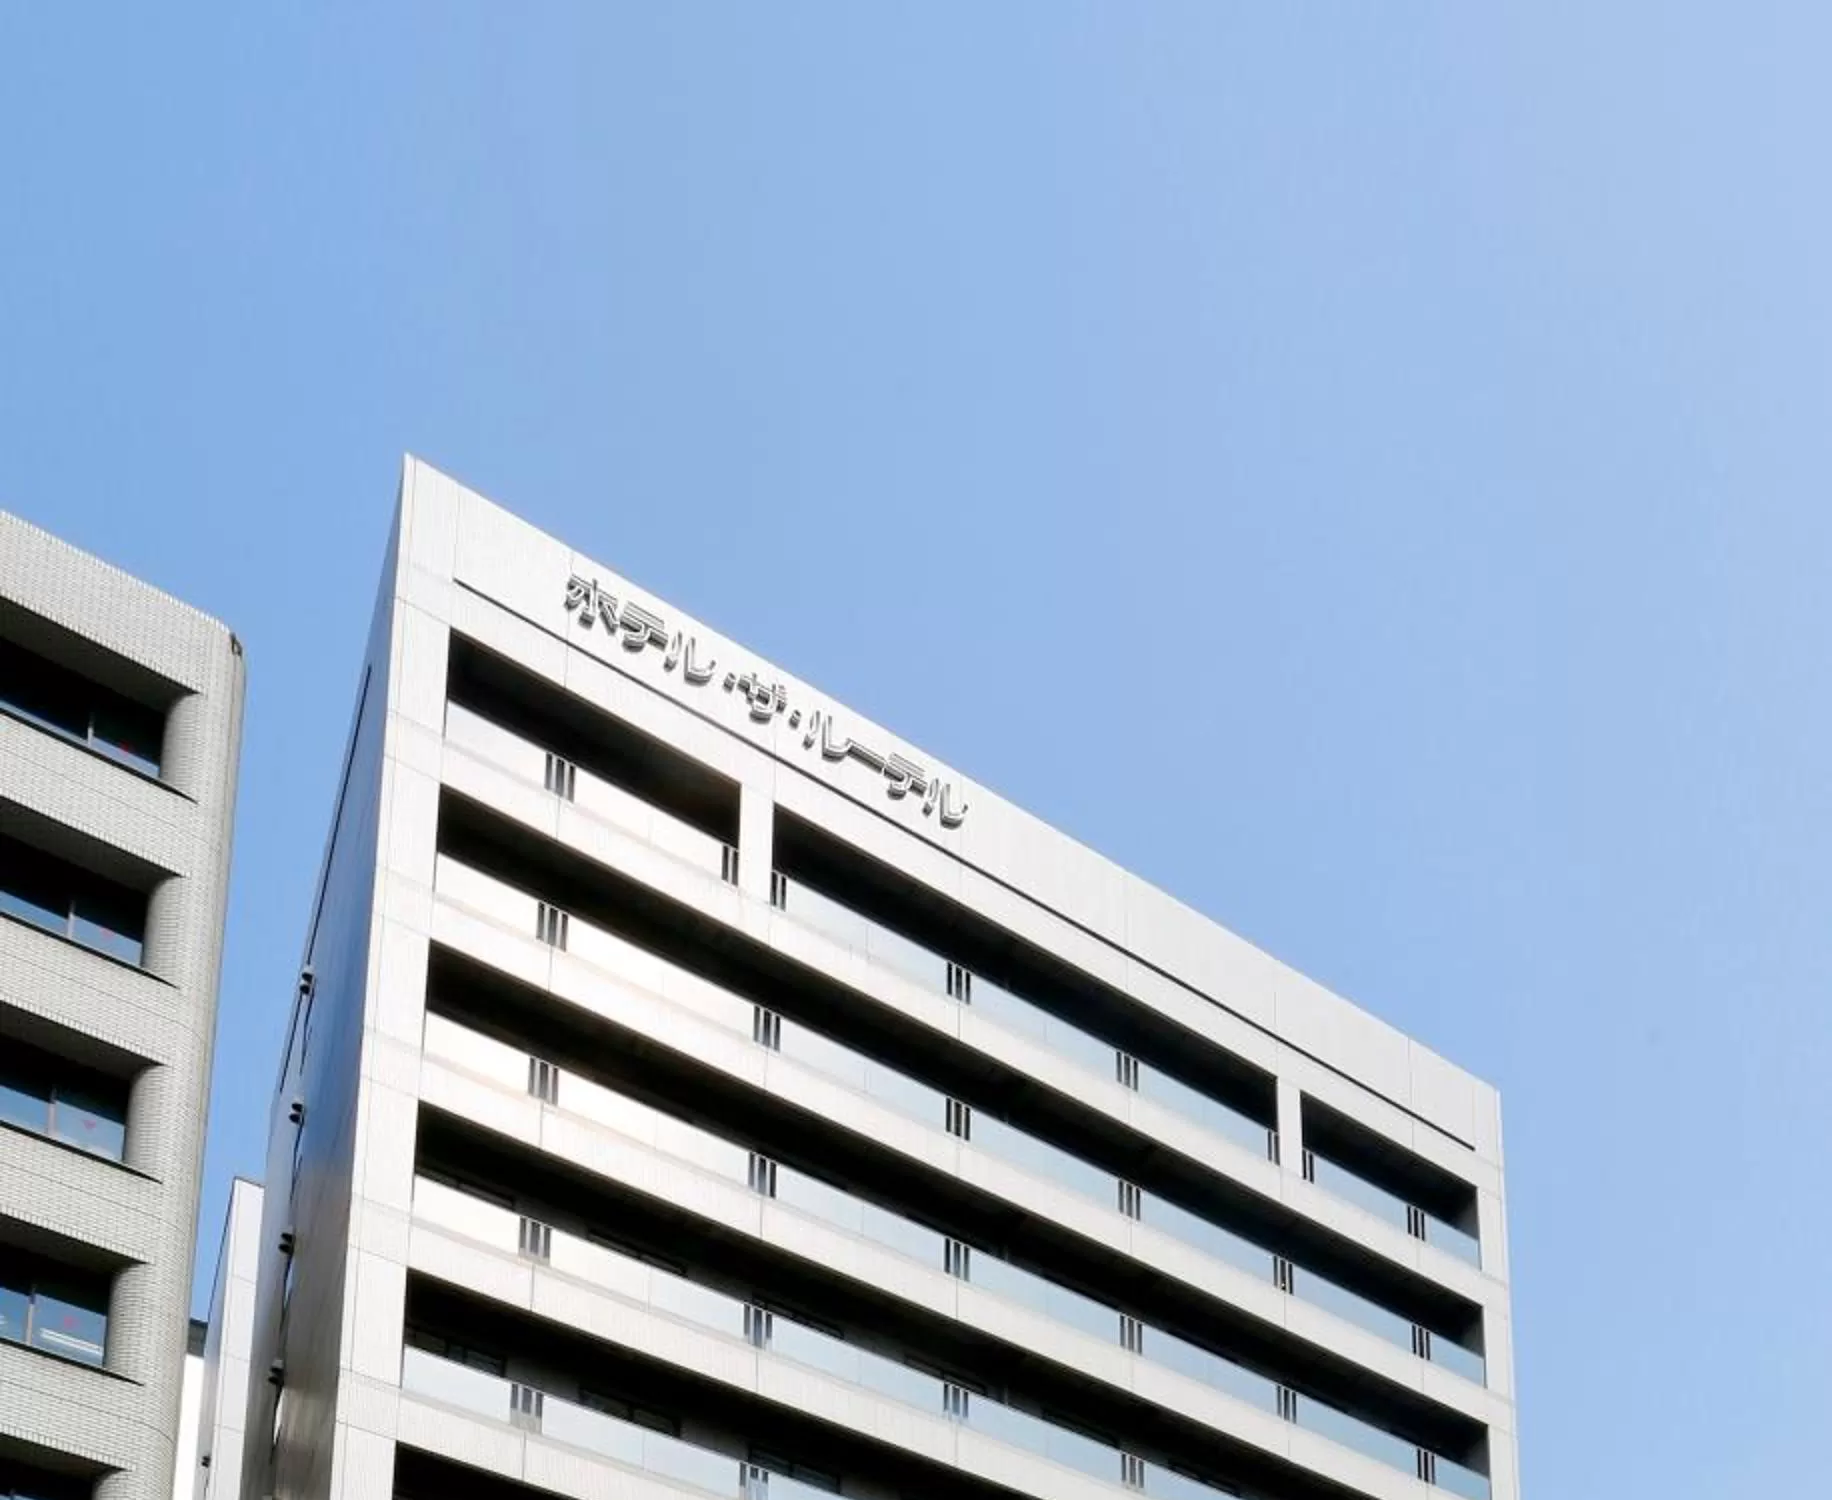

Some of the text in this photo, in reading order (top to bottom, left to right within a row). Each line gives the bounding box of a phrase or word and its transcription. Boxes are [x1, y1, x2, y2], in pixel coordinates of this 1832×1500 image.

[565, 573, 969, 828] ホテル・ザ・ルーテル
